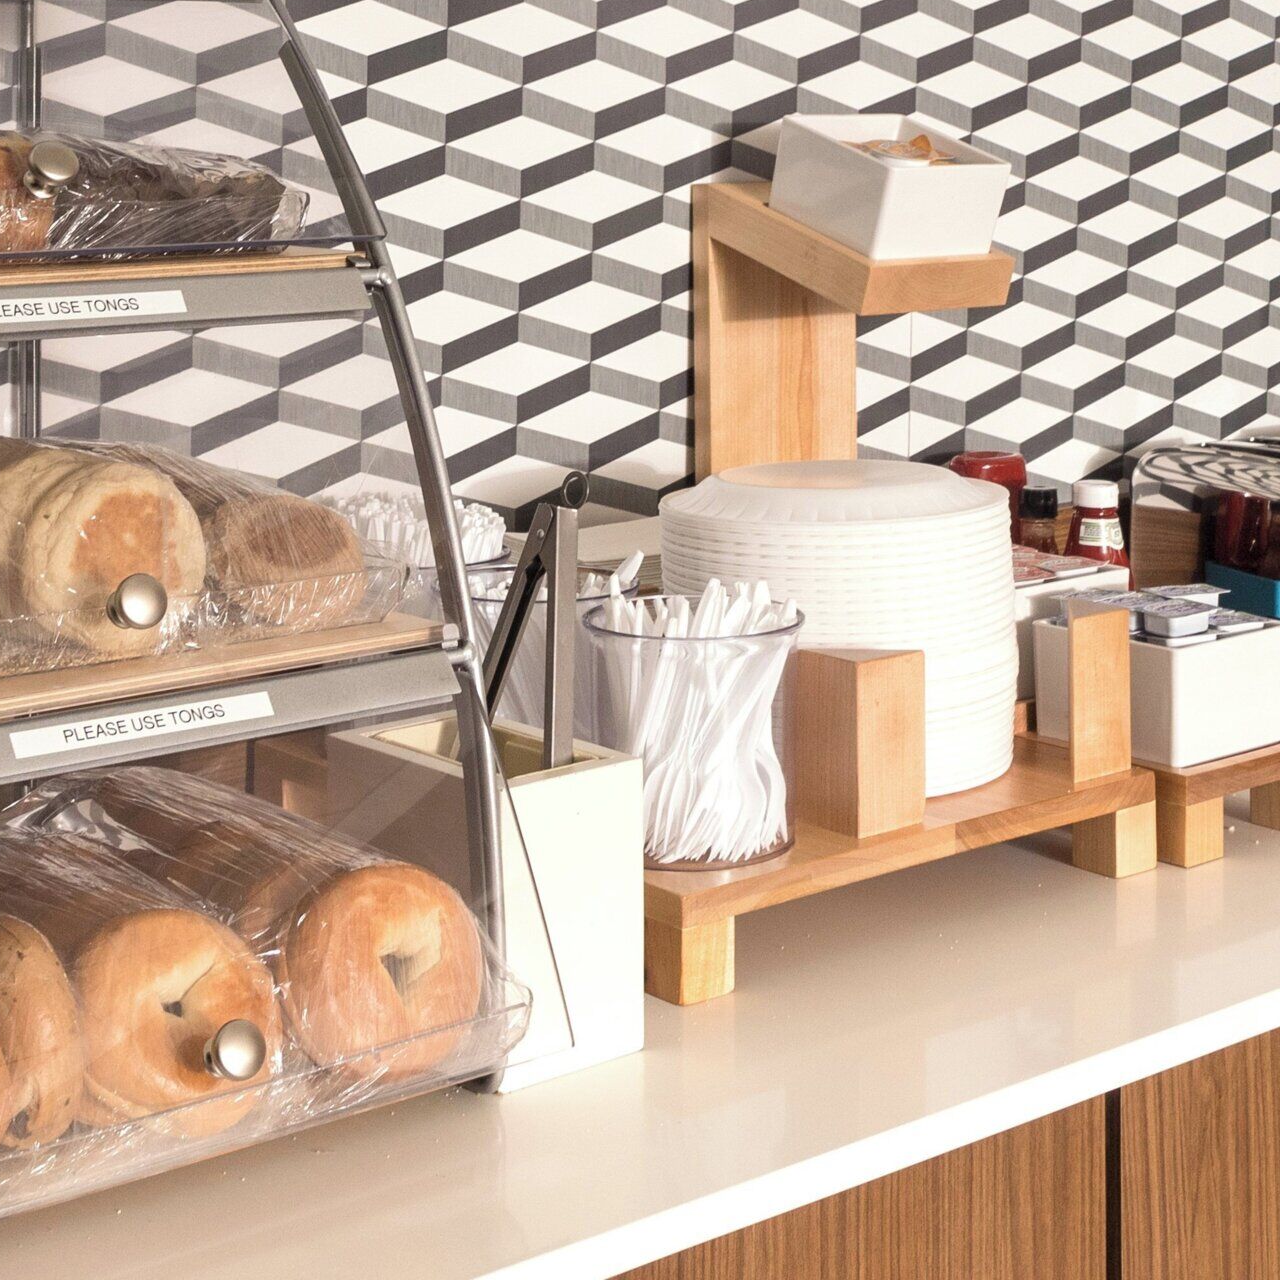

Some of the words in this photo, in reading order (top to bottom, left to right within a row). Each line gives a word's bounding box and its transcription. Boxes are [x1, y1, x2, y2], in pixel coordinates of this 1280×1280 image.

[48, 300, 81, 315] USE
[84, 298, 140, 313] TONGS
[63, 720, 128, 743] PLEASE
[132, 713, 167, 733] USE
[168, 703, 226, 726] TONGS
